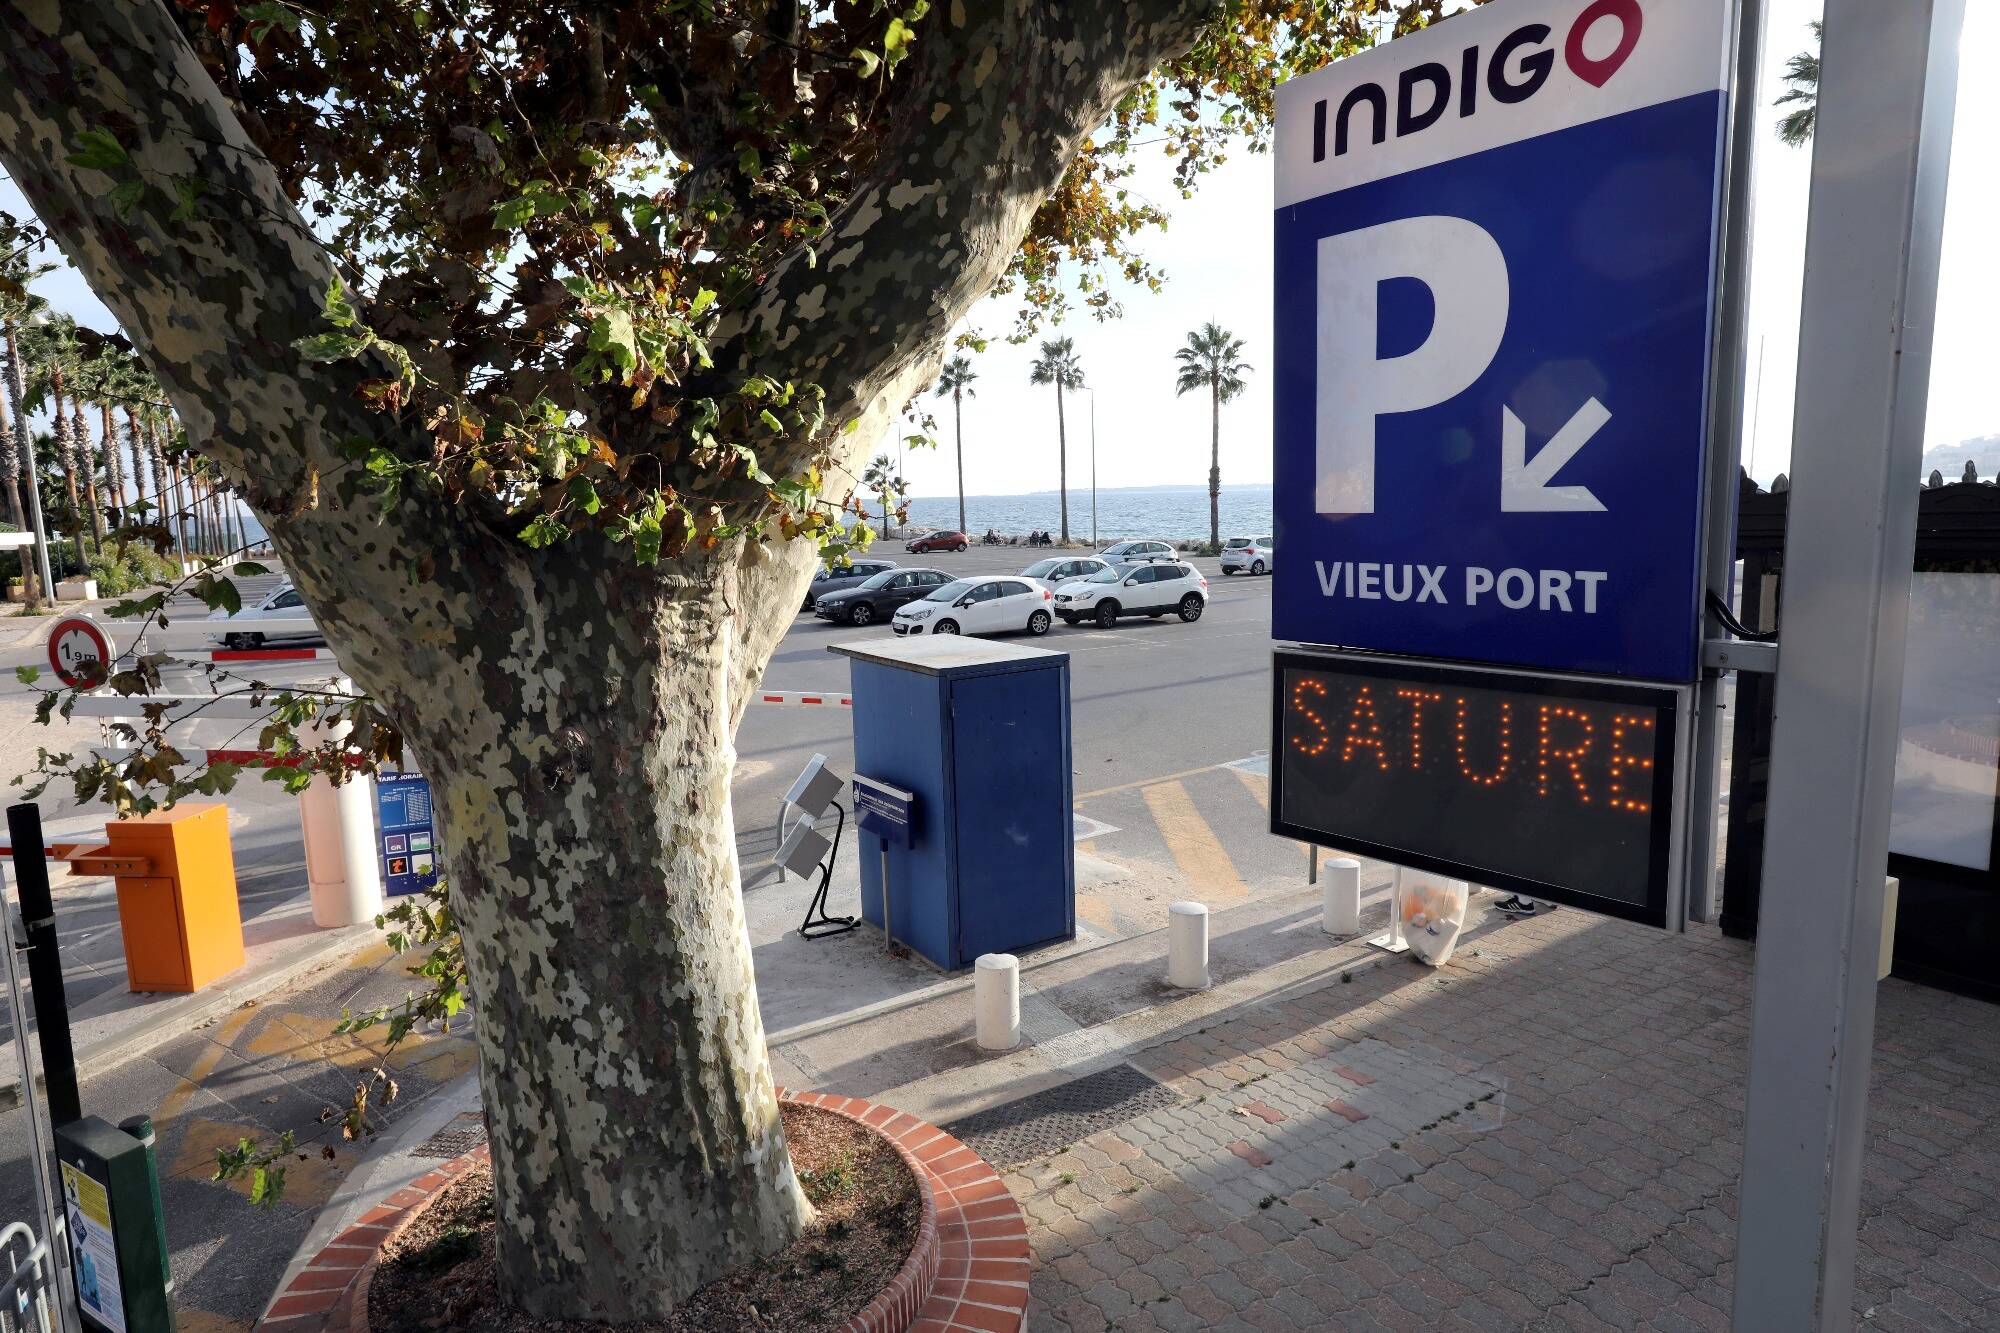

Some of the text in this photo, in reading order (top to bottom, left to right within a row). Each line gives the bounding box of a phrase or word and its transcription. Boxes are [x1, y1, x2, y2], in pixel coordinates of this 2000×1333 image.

[1313, 0, 1642, 163] INDIGO
[1316, 215, 1510, 514] P
[1315, 560, 1608, 614] VIEUX PORT
[1293, 679, 1653, 812] SATURE
